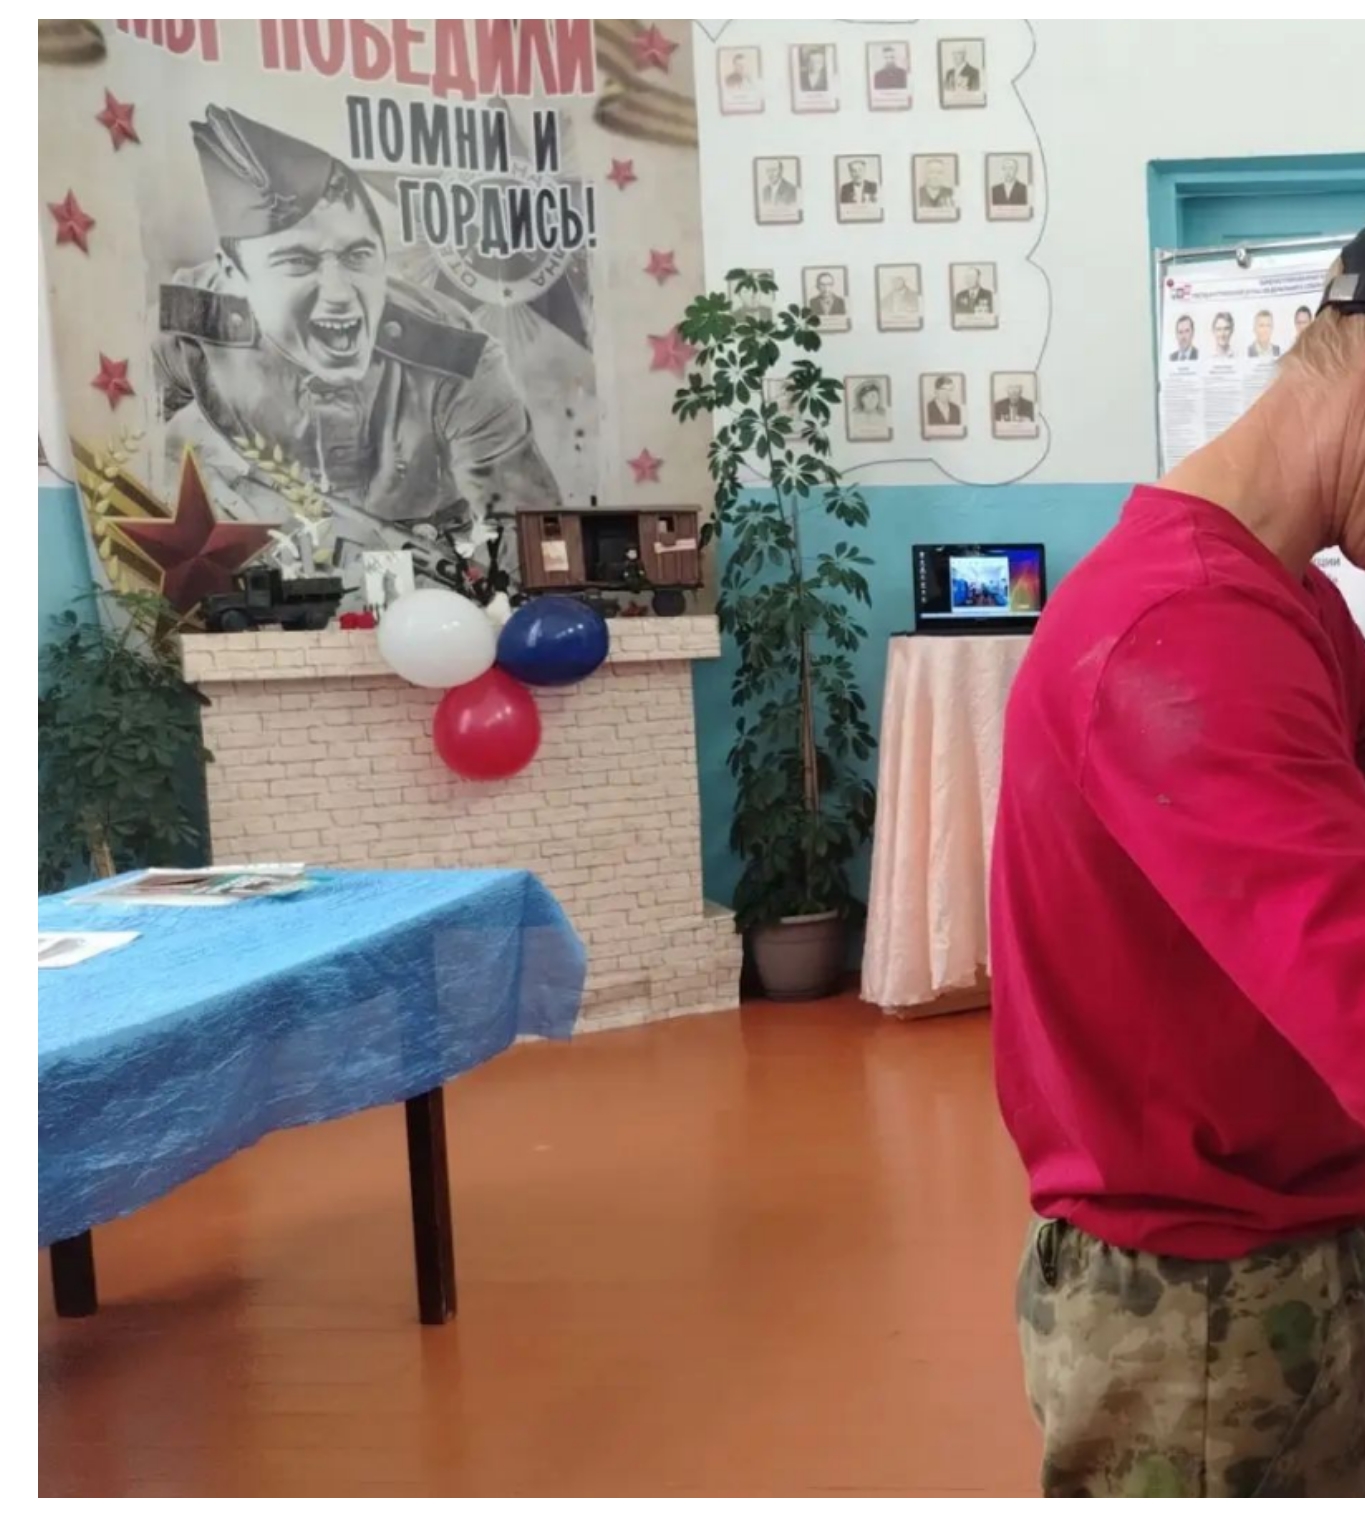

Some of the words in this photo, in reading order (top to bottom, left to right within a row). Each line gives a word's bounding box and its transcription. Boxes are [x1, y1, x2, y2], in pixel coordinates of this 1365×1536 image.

[346, 95, 509, 173] ПОМНИ
[533, 110, 559, 173] И
[398, 179, 597, 257] ГОРДИСЬ!
